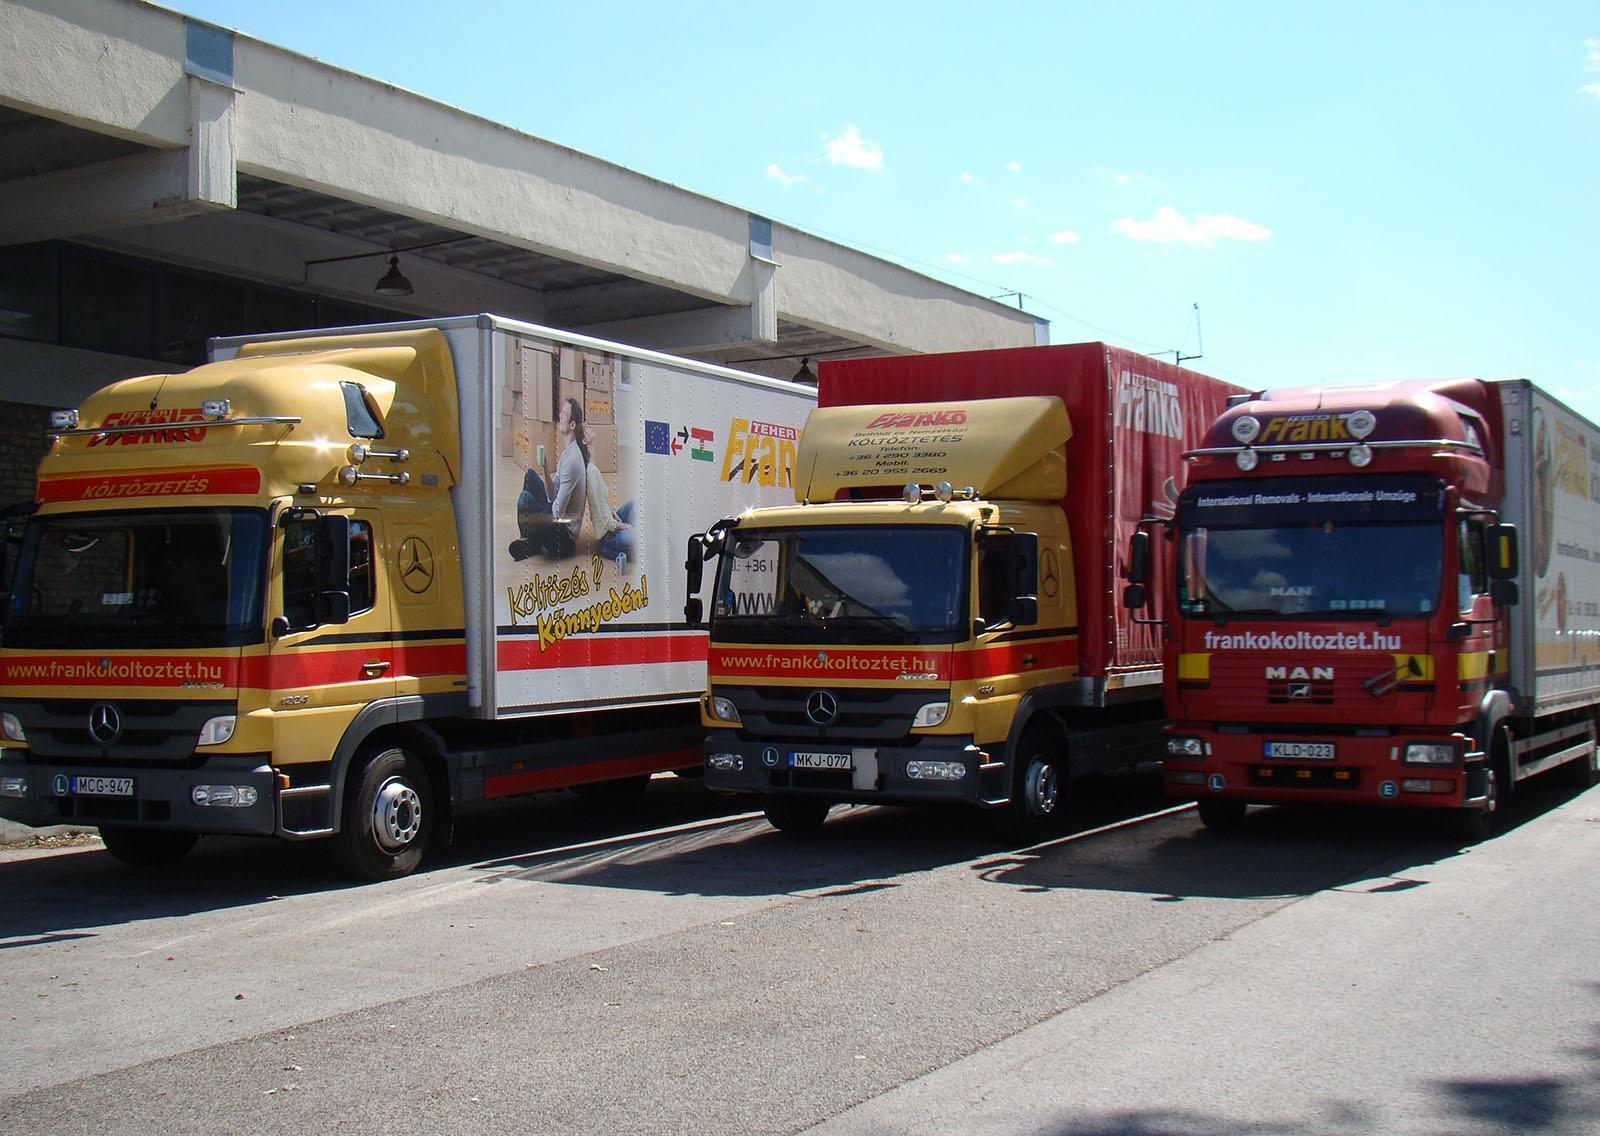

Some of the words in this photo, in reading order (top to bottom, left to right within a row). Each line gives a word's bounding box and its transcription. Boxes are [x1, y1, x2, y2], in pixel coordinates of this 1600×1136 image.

[752, 422, 795, 440] TEHER
[721, 417, 802, 488] Fran
[835, 469, 858, 477] +36
[81, 474, 209, 499] KÖLTÖZTETÉS
[745, 560, 767, 572] +36
[508, 565, 589, 626] Költözés
[1205, 631, 1401, 650] frankokoltoztet.hu
[6, 660, 222, 680] www.frankokoltoztet.hu
[720, 653, 936, 672] www.frankokoltoztet.hu
[1265, 667, 1334, 679] MAN
[1274, 744, 1332, 757] KLD-023
[796, 756, 849, 768] MKJ-077
[78, 778, 131, 793] MCG-947
